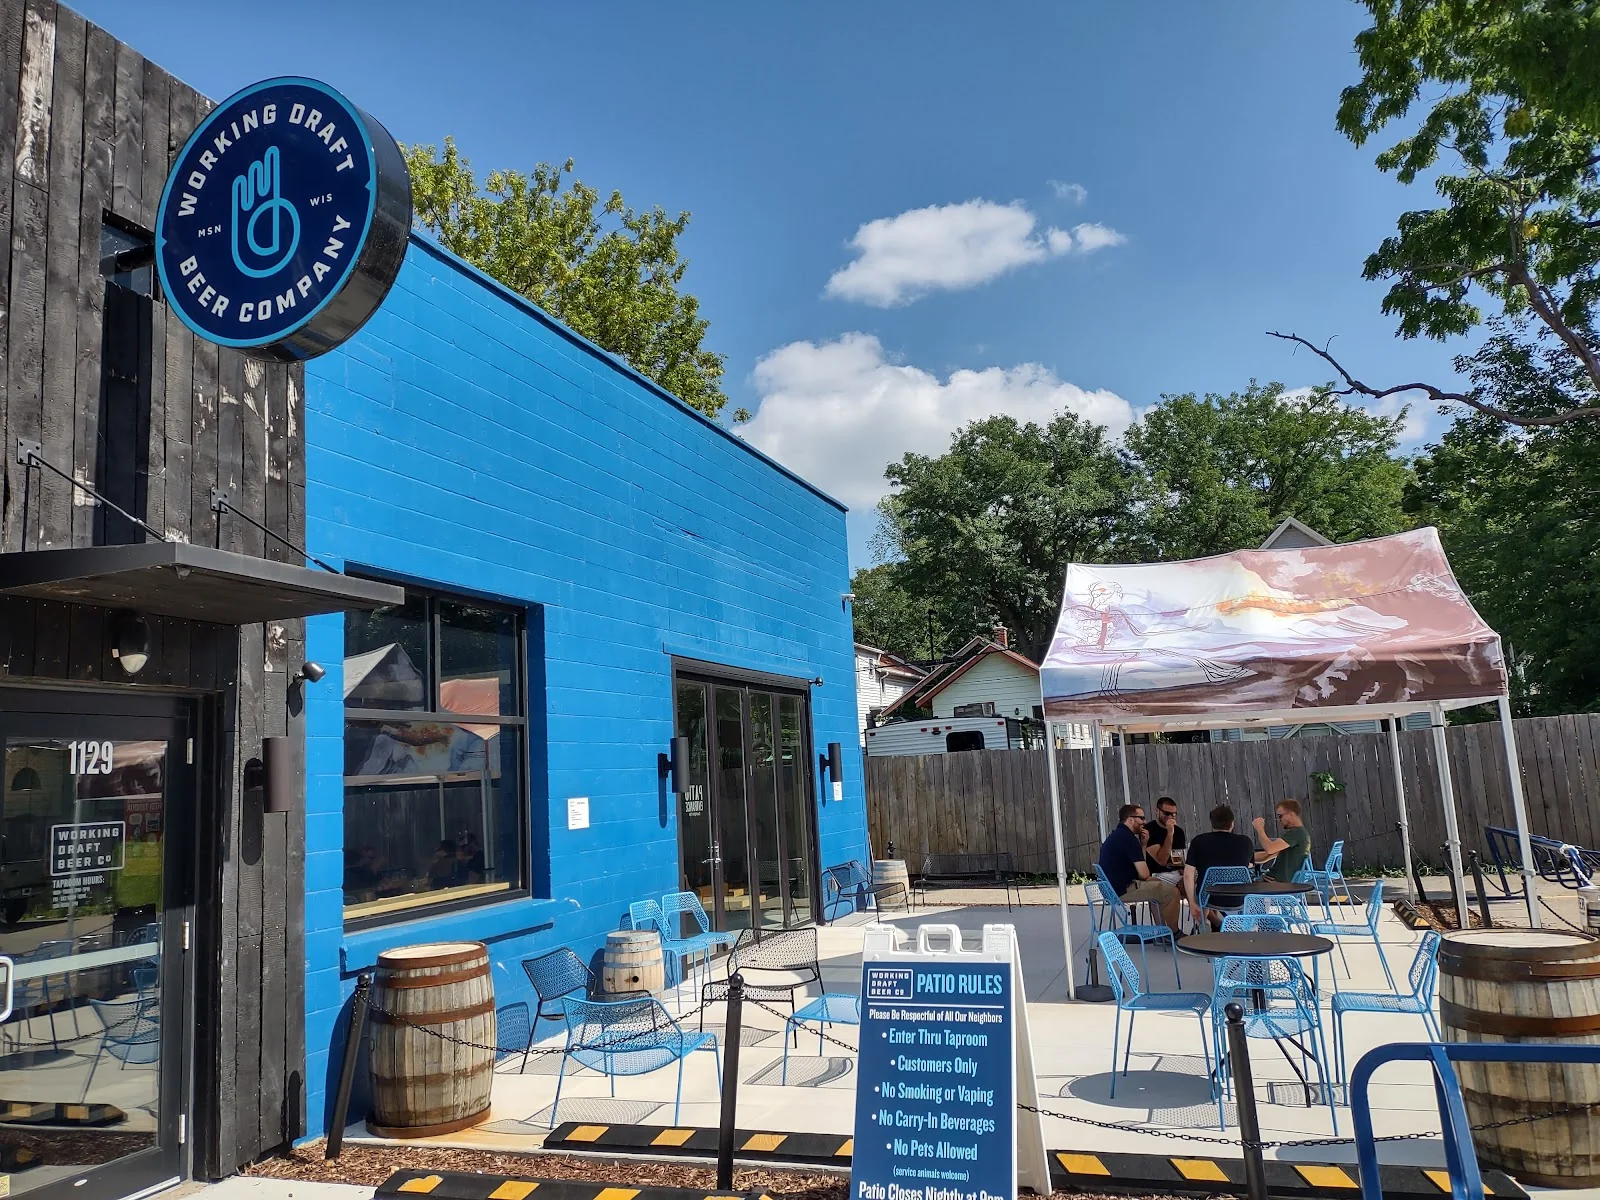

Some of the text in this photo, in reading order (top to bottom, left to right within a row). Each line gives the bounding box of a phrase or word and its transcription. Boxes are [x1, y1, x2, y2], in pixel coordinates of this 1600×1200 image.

[178, 103, 354, 217] WORKING DRAFT
[309, 193, 333, 206] WIS
[198, 224, 222, 237] MSN
[179, 214, 351, 322] BEER COMPANY
[68, 740, 113, 775] 1129
[58, 828, 119, 841] WORKING
[58, 843, 100, 855] DRAFT
[57, 857, 91, 869] BEER
[52, 875, 105, 889] TAPROOM HOURS:
[917, 973, 1003, 995] PATIO RULES
[869, 1009, 1003, 1025] Please Be Respectful of All Our Neighbors
[889, 1027, 988, 1049] Enter Thru Taproom
[897, 1055, 978, 1077] Customers Only
[881, 1081, 994, 1106] No Smoking or Vaping
[878, 1109, 995, 1135] No Carry-In Beverages
[893, 1138, 978, 1161] No Pets Allowed
[893, 1165, 970, 1182] (service animals welcome)
[858, 1180, 886, 1200] Patio
[888, 1183, 923, 1200] Closes
